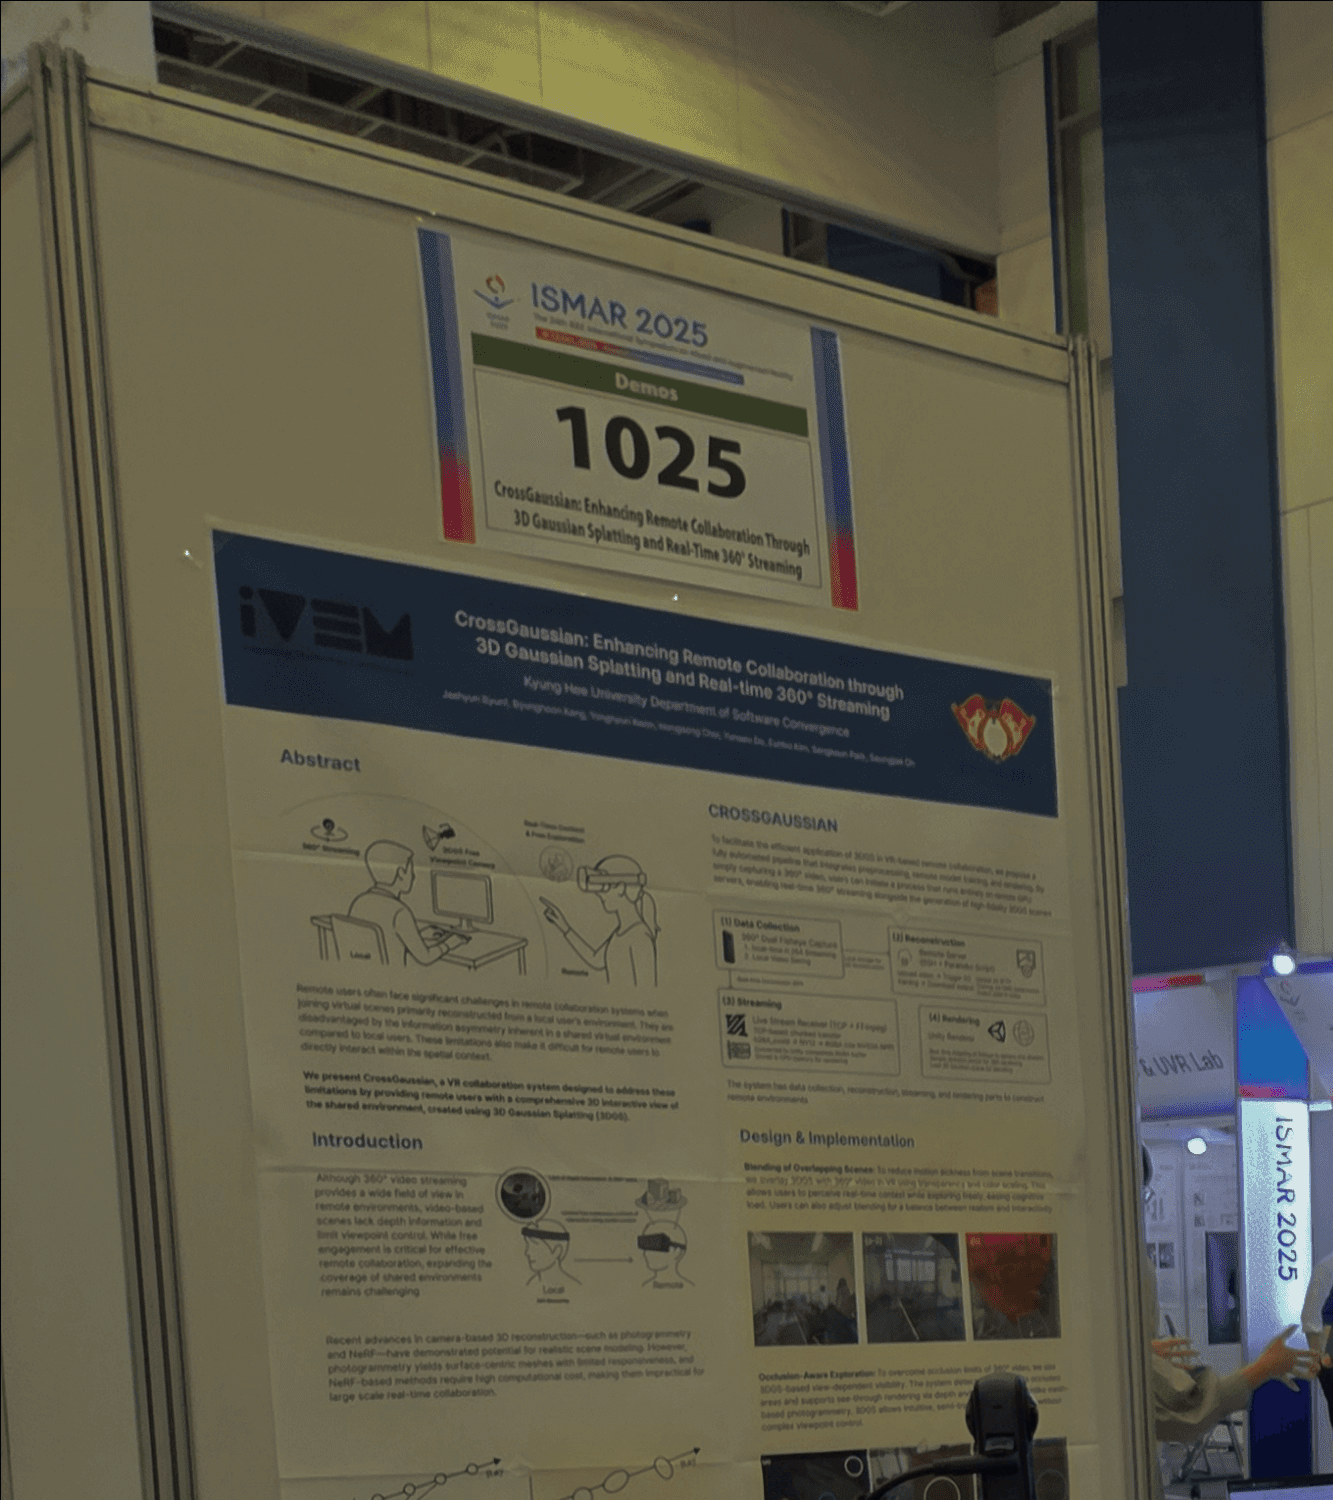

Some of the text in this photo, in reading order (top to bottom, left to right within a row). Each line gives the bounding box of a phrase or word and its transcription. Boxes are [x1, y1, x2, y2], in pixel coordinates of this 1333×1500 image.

[531, 283, 626, 327] ISMAR
[635, 308, 708, 347] 2025
[615, 372, 678, 400] Demos
[556, 407, 745, 497] 1025
[494, 480, 810, 557] CrossGaussian: Enhancing Remote Collaboration Through
[513, 508, 530, 526] 3D
[532, 512, 585, 536] Gaussian
[586, 522, 640, 550] Splatting
[642, 536, 664, 551] and
[665, 537, 719, 561] Real-Time
[747, 553, 802, 581] Streaming
[454, 610, 903, 701] CrossGaussian: Enhancing Remote Collaboration through
[475, 636, 500, 655] 3D
[504, 642, 583, 668] Gaussian
[587, 655, 661, 684] Splatting
[665, 670, 695, 686] and
[698, 673, 772, 698] Real-time
[817, 693, 890, 721] Streaming
[280, 749, 360, 771] Abstract
[708, 804, 837, 831] CROSSGAUSSIAN
[1139, 1049, 1224, 1077] & UVR Lab
[312, 1132, 422, 1149] Introduction
[739, 1128, 914, 1147] Design & Implementation
[1275, 1117, 1299, 1281] ISMAR 2025
